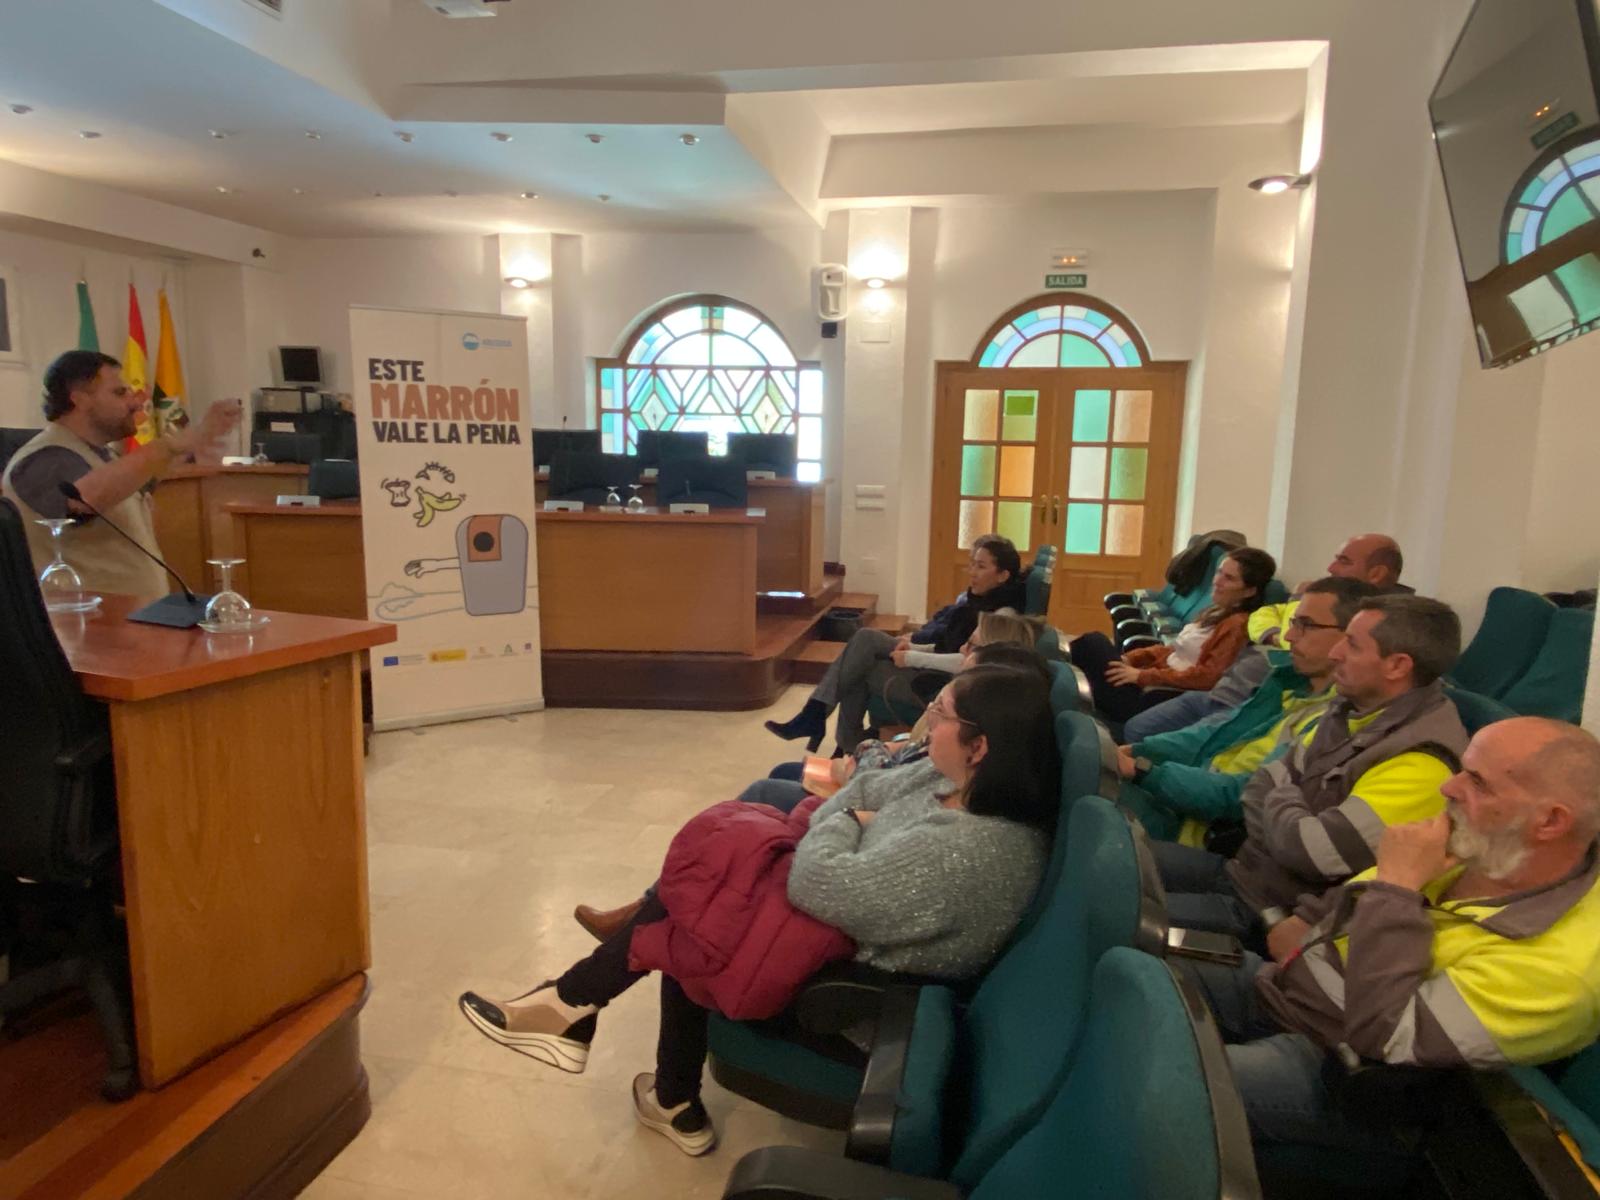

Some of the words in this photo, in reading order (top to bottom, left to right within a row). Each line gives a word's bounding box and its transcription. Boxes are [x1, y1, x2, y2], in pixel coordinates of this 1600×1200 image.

[1048, 276, 1084, 286] SALIDA
[368, 358, 425, 382] ESTE
[370, 378, 520, 422] MARRÓN
[372, 421, 428, 443] VALE
[433, 422, 462, 444] LA
[467, 423, 521, 445] PENA
